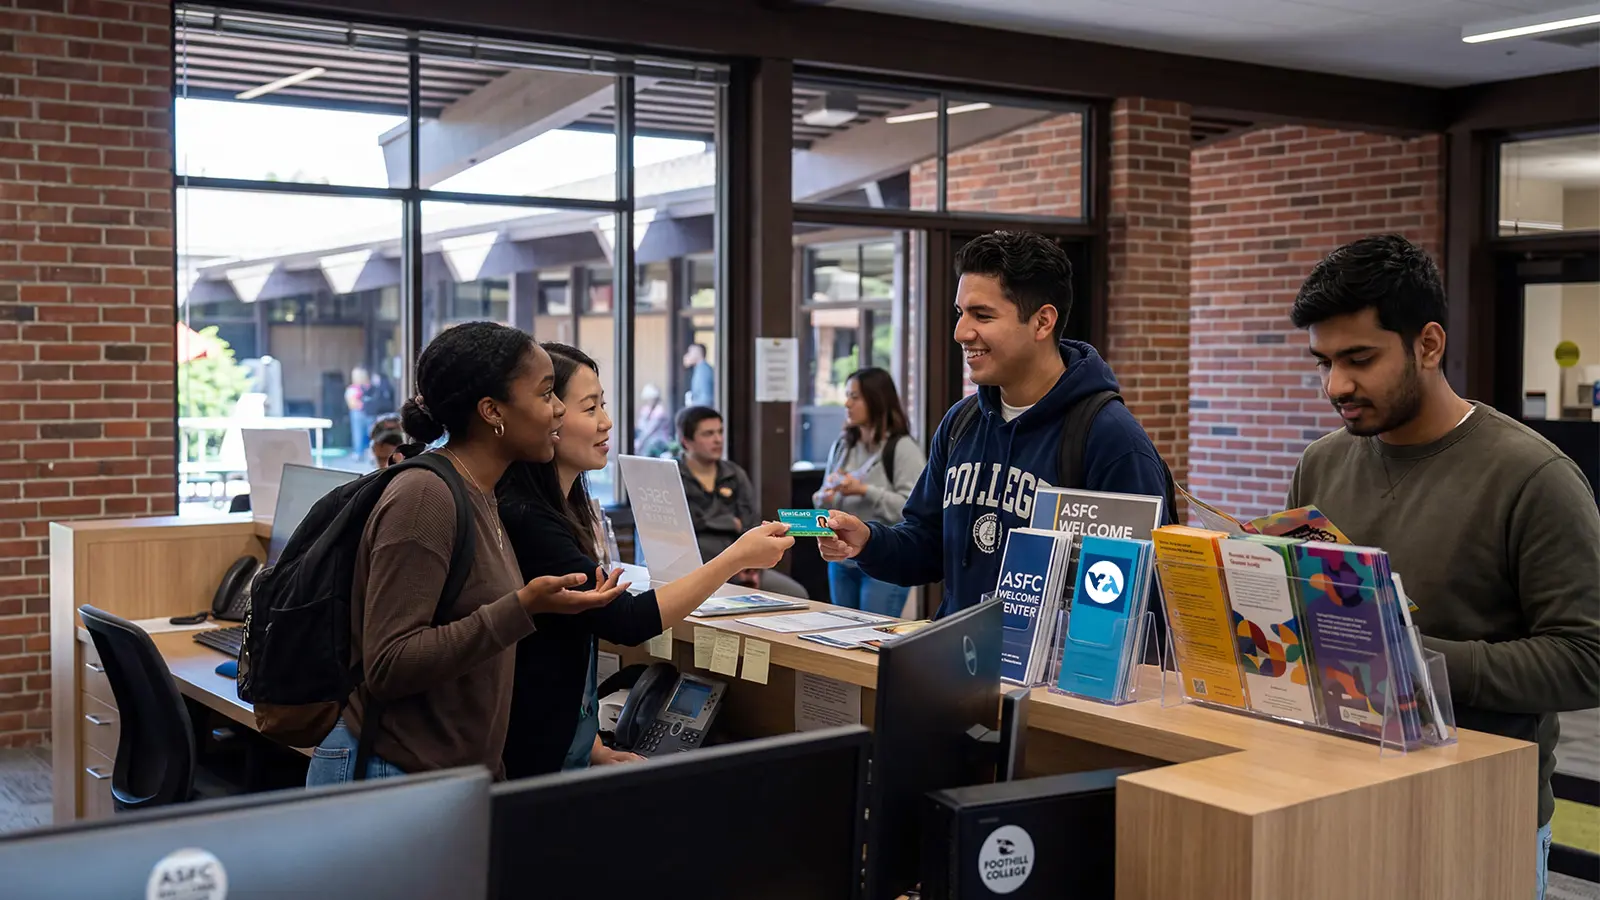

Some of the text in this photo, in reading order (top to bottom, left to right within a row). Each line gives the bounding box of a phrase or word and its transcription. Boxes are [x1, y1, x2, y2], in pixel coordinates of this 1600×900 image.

[943, 462, 1052, 519] COLLEG
[1060, 502, 1099, 519] ASFC
[1058, 519, 1133, 539] WELCOME
[1001, 571, 1043, 592] ASFC
[998, 589, 1040, 605] WELCOME
[1002, 601, 1037, 618] ENTER
